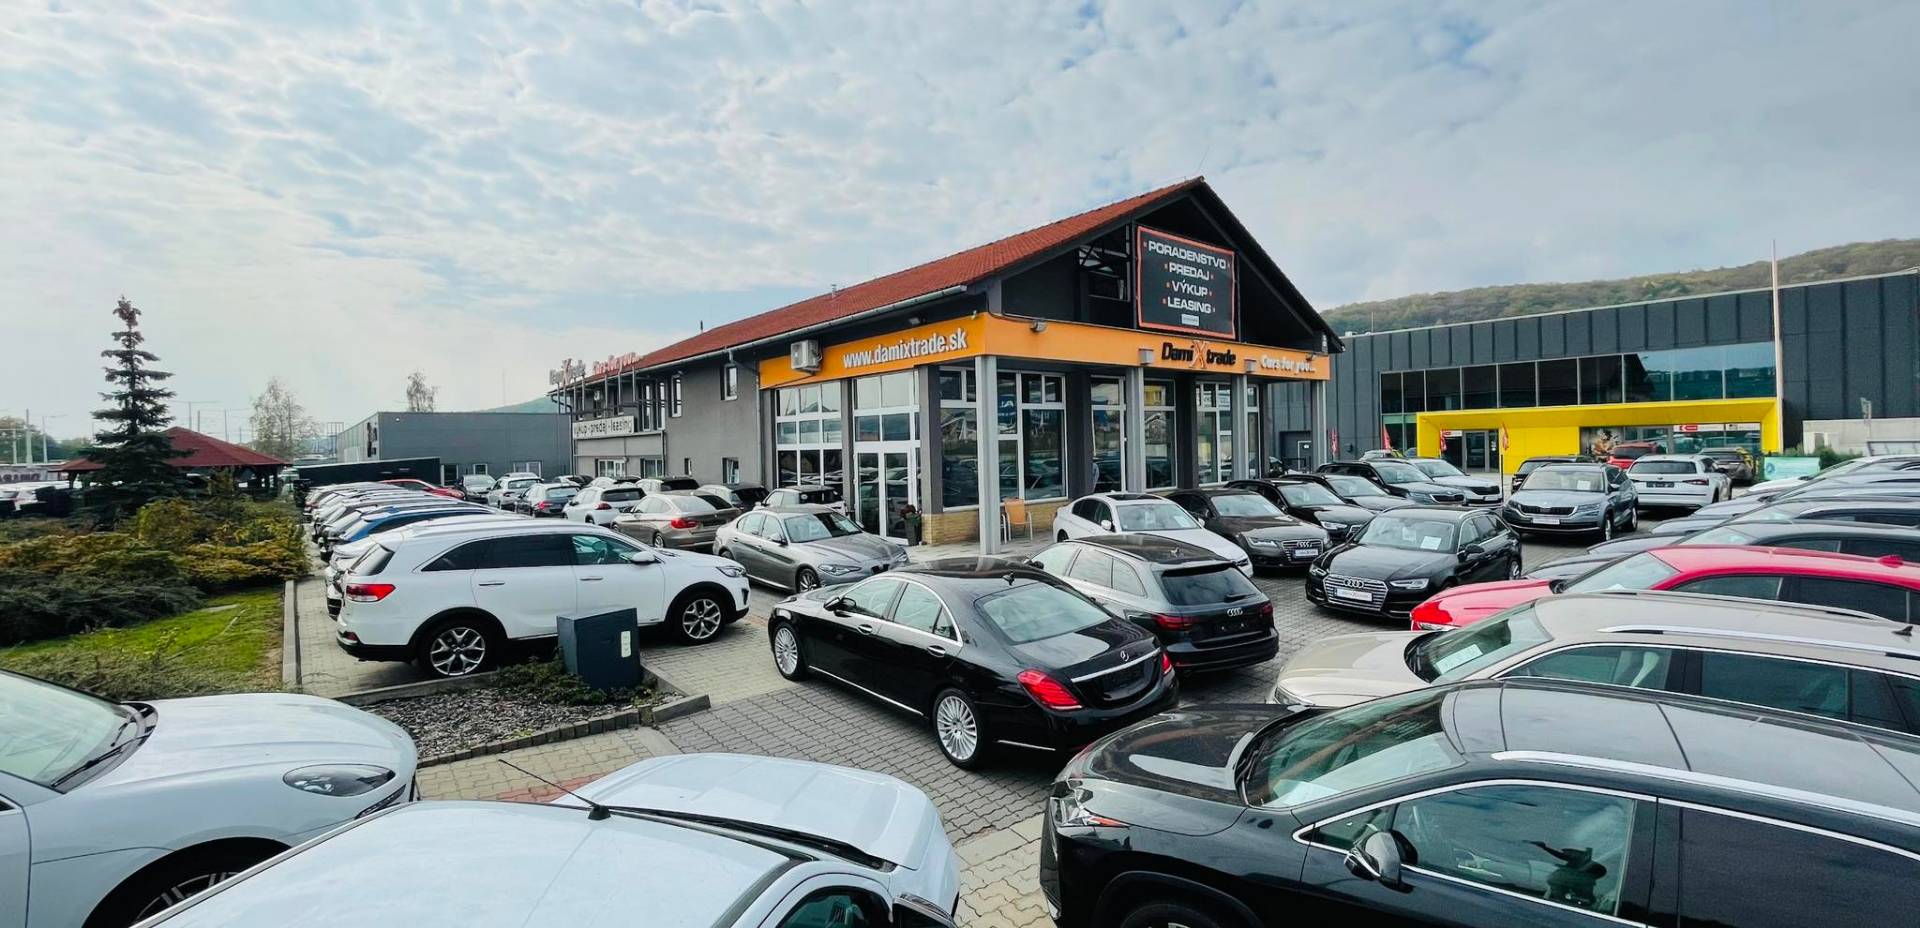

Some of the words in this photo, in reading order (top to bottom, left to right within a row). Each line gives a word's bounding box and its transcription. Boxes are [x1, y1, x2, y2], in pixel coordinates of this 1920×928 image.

[1148, 240, 1226, 270] PORADENSTVO
[1168, 261, 1210, 281] PREDAJ
[1171, 279, 1208, 297] VÝKUP
[1167, 296, 1212, 314] LEASING
[843, 328, 967, 368] www.damixtrade.sk
[1281, 356, 1295, 371] for
